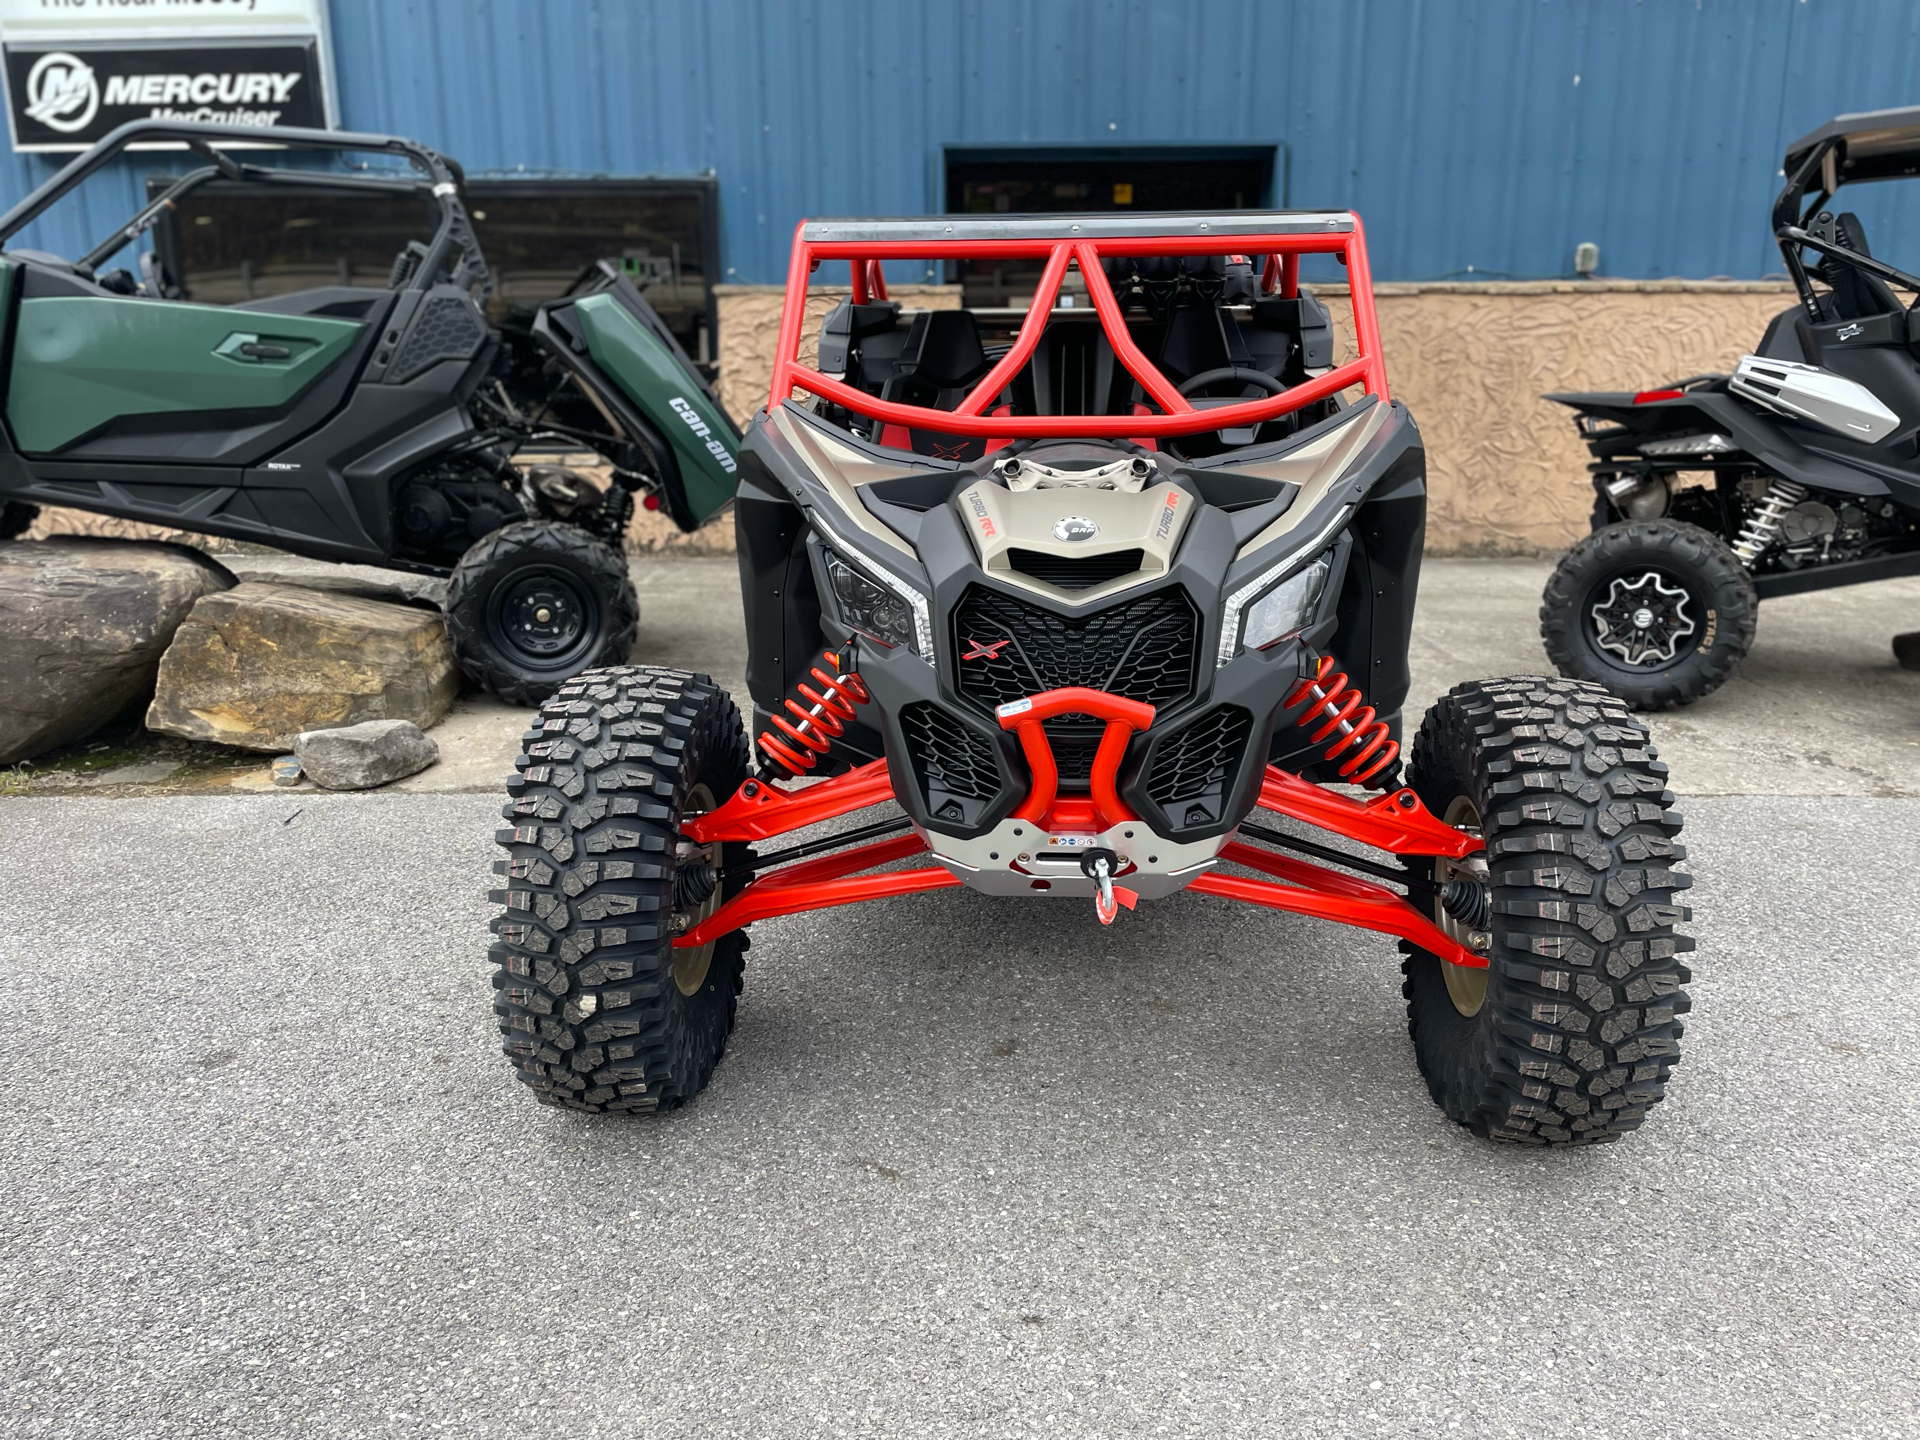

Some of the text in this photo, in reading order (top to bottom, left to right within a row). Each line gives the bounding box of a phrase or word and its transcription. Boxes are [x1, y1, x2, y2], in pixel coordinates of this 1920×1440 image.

[103, 73, 302, 104] MERCURY
[669, 397, 737, 473] can-am
[268, 462, 292, 470] ROTAX
[968, 491, 996, 537] TURBO RR
[1156, 491, 1180, 540] TURBO RR
